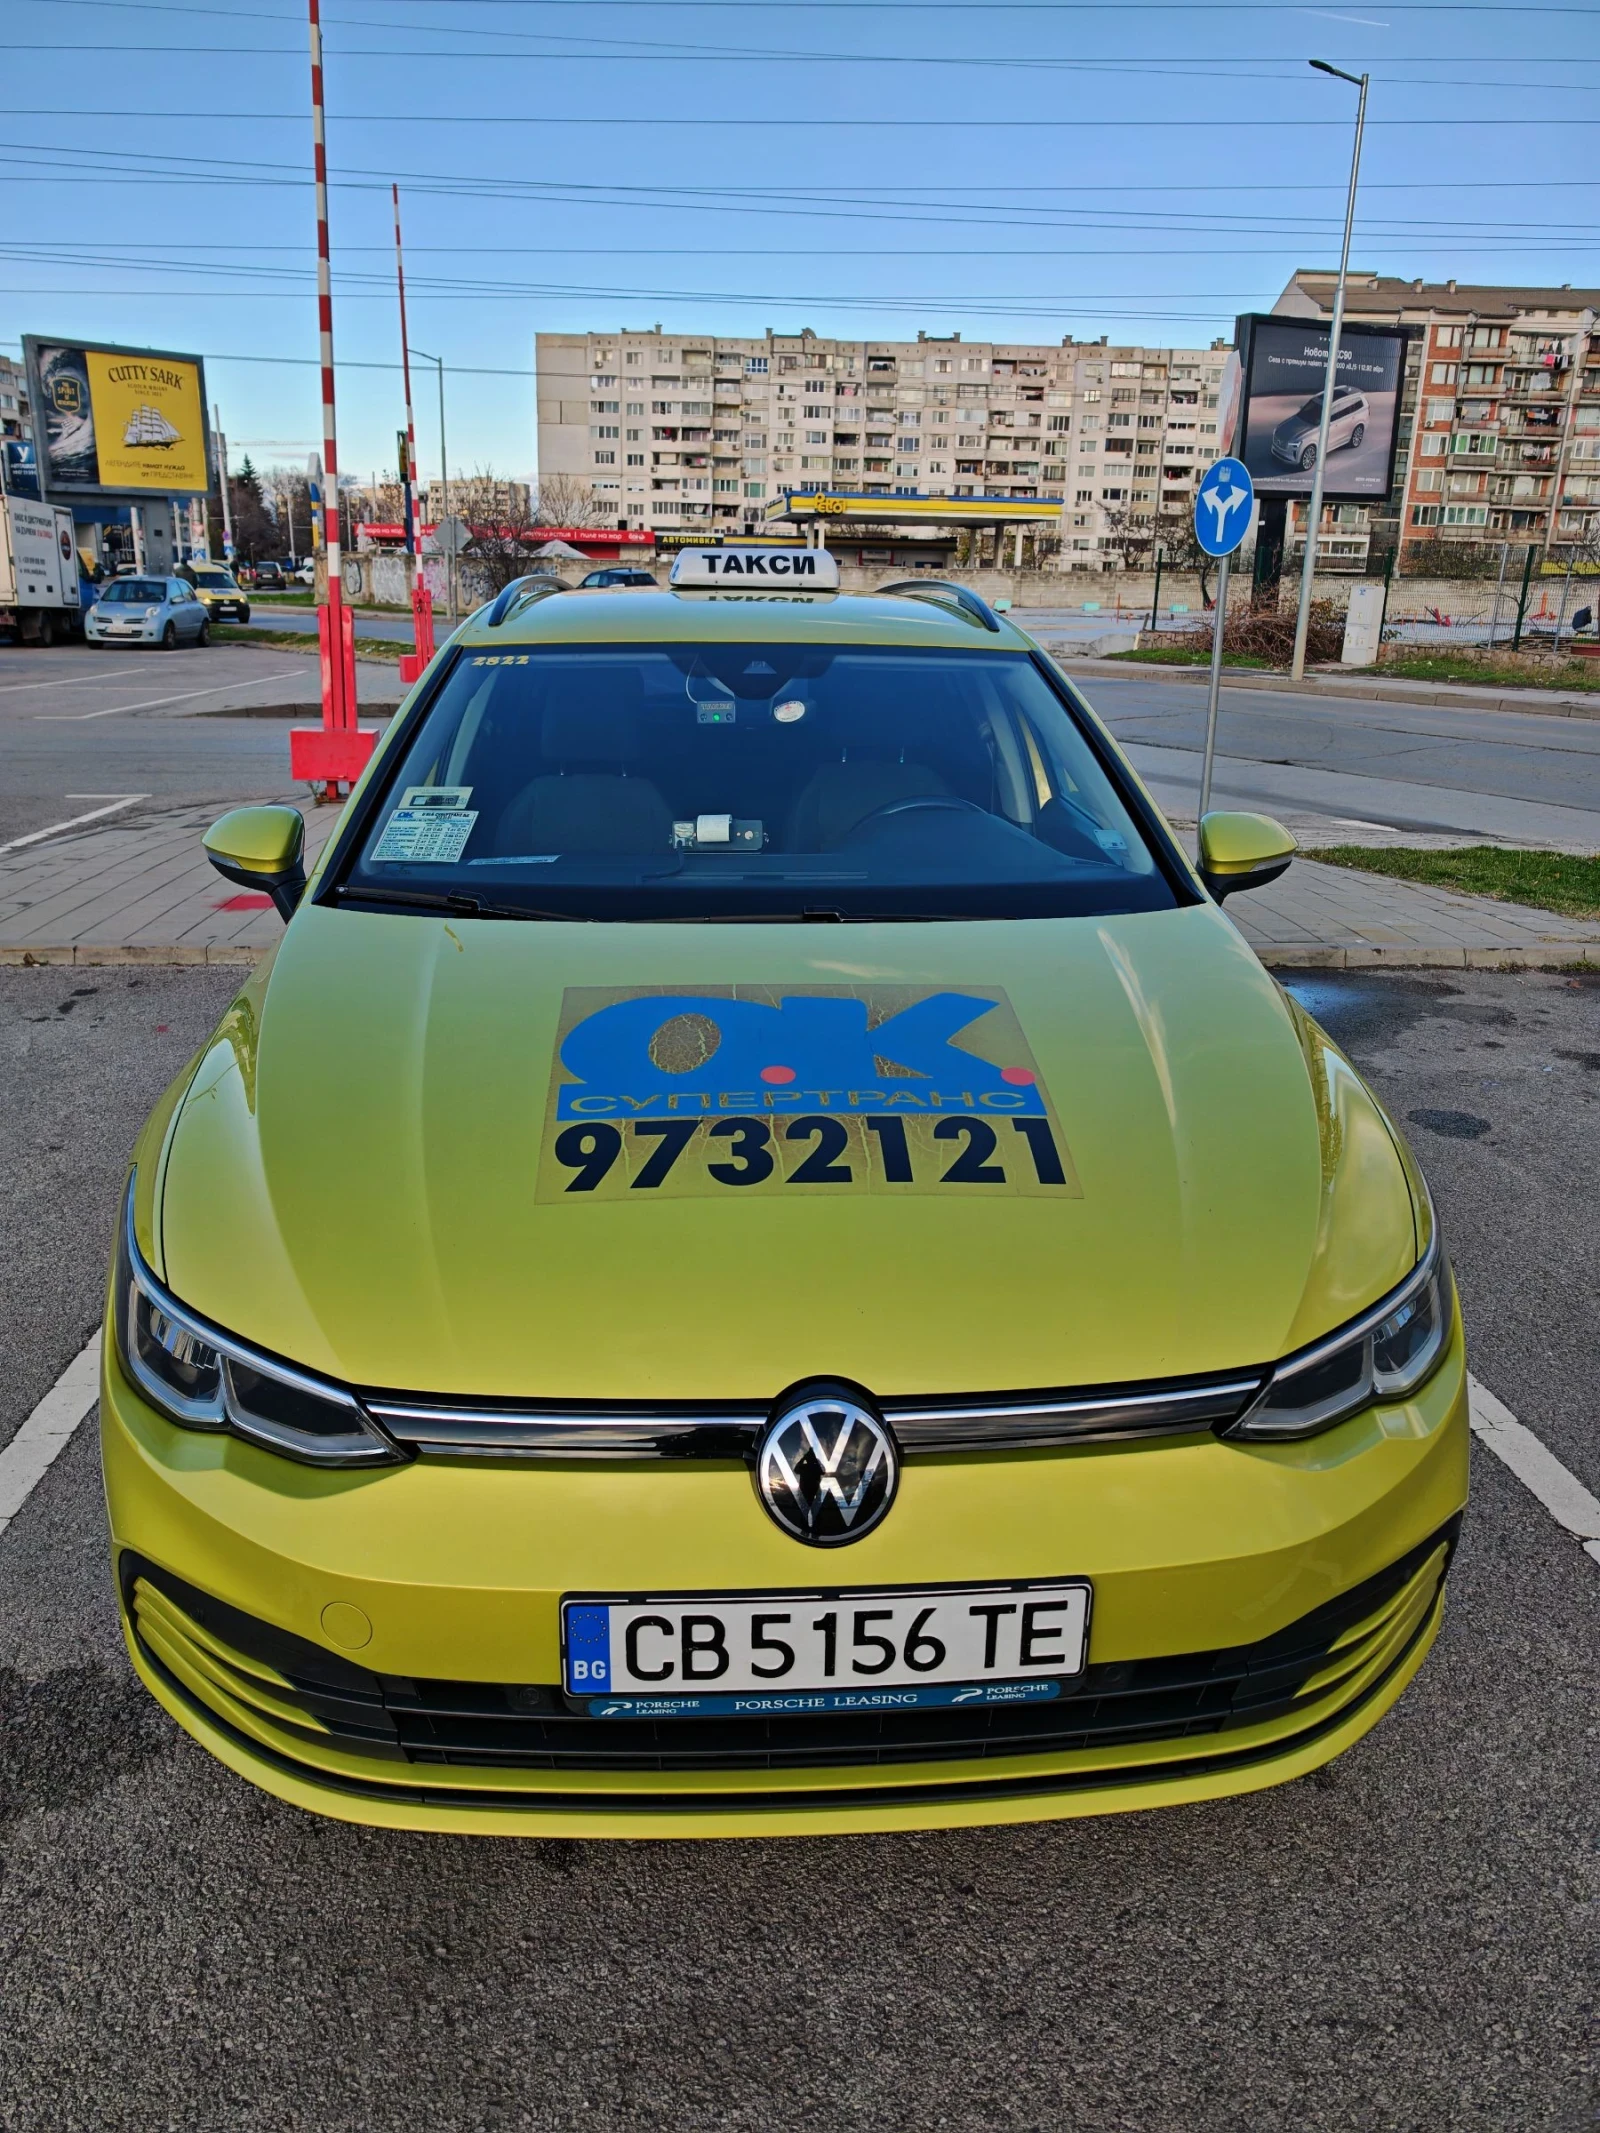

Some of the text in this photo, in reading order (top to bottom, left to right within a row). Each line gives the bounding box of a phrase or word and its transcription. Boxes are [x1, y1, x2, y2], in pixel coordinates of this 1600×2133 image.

[108, 365, 183, 390] CUTTY SARK
[662, 536, 716, 544] АВТОМИВКА
[702, 555, 815, 575] ТАКСИ
[471, 656, 529, 666] 2822
[570, 1089, 1027, 1113] СУПЕРТРАНС
[554, 1115, 1067, 1192] 9732121
[624, 1600, 1069, 1681] CB 5156 TE
[573, 1660, 607, 1680] BG
[986, 1684, 1049, 1695] PORSCHE
[636, 1700, 700, 1709] PORSCHE
[735, 1693, 918, 1711] PORSCHE LEASING
